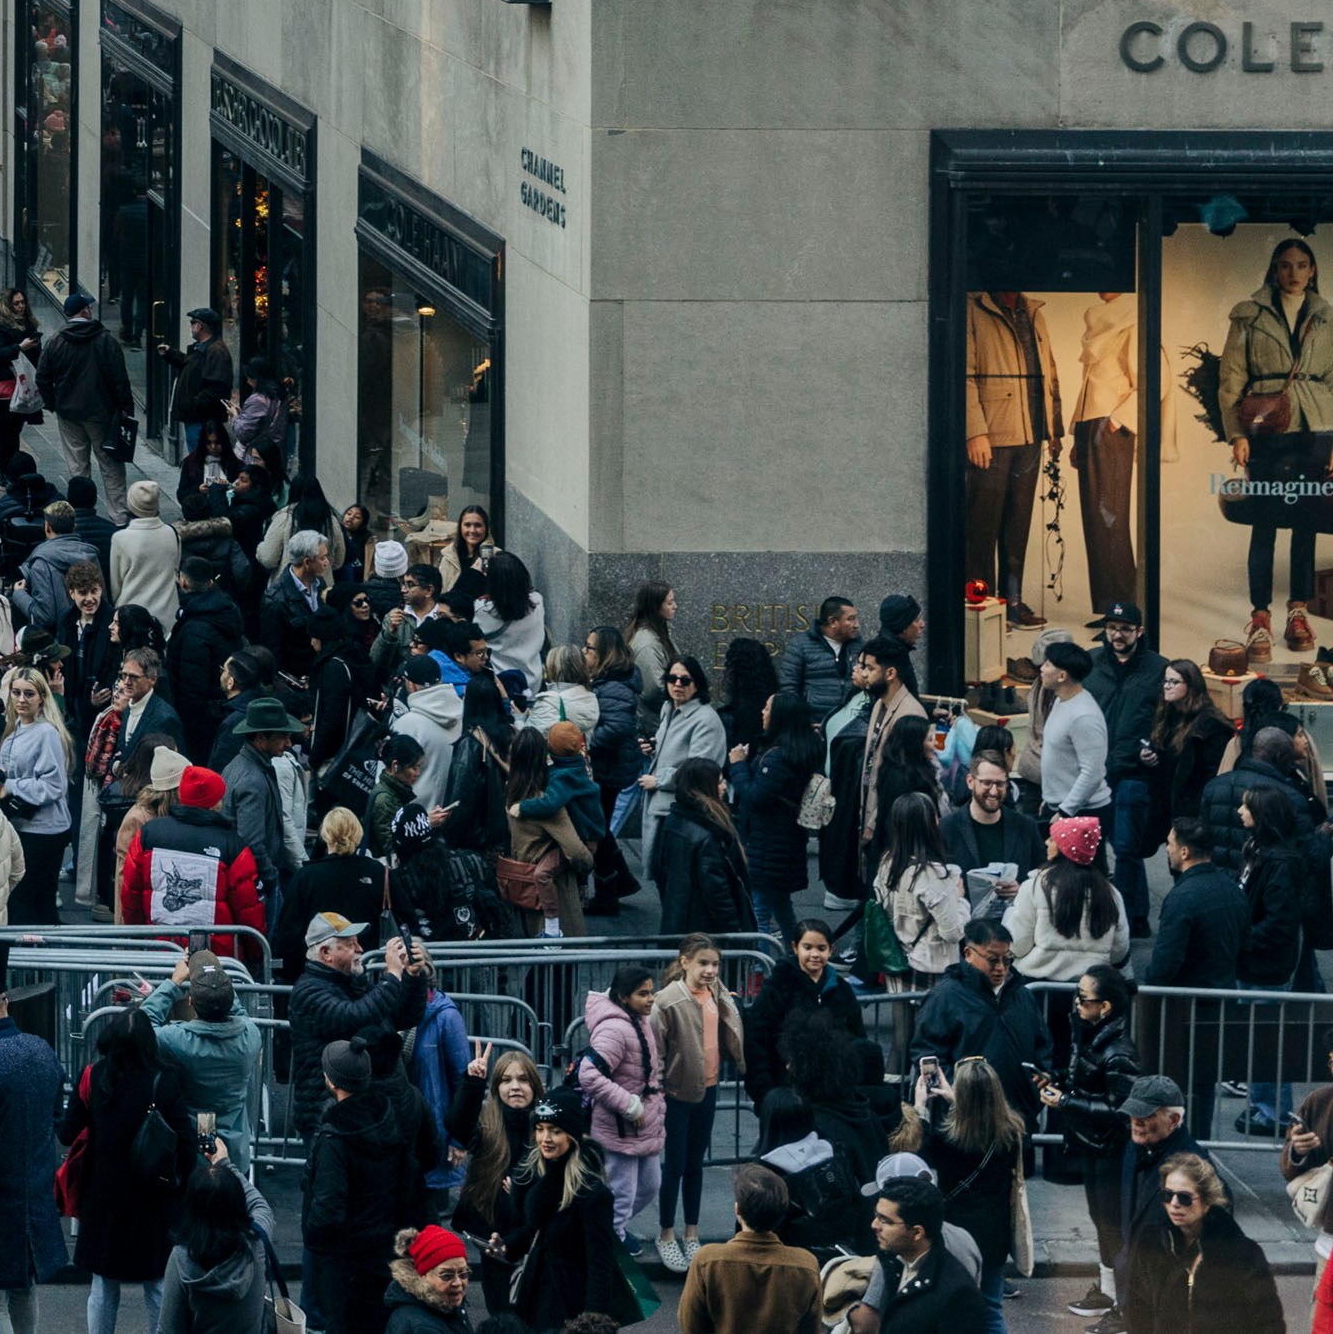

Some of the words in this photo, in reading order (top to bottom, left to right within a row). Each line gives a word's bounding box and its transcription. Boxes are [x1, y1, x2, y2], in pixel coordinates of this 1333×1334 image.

[1119, 21, 1324, 73] COLE
[521, 146, 566, 194] CHANNEL
[520, 180, 566, 229] GARDENS
[710, 604, 821, 633] BRITIS
